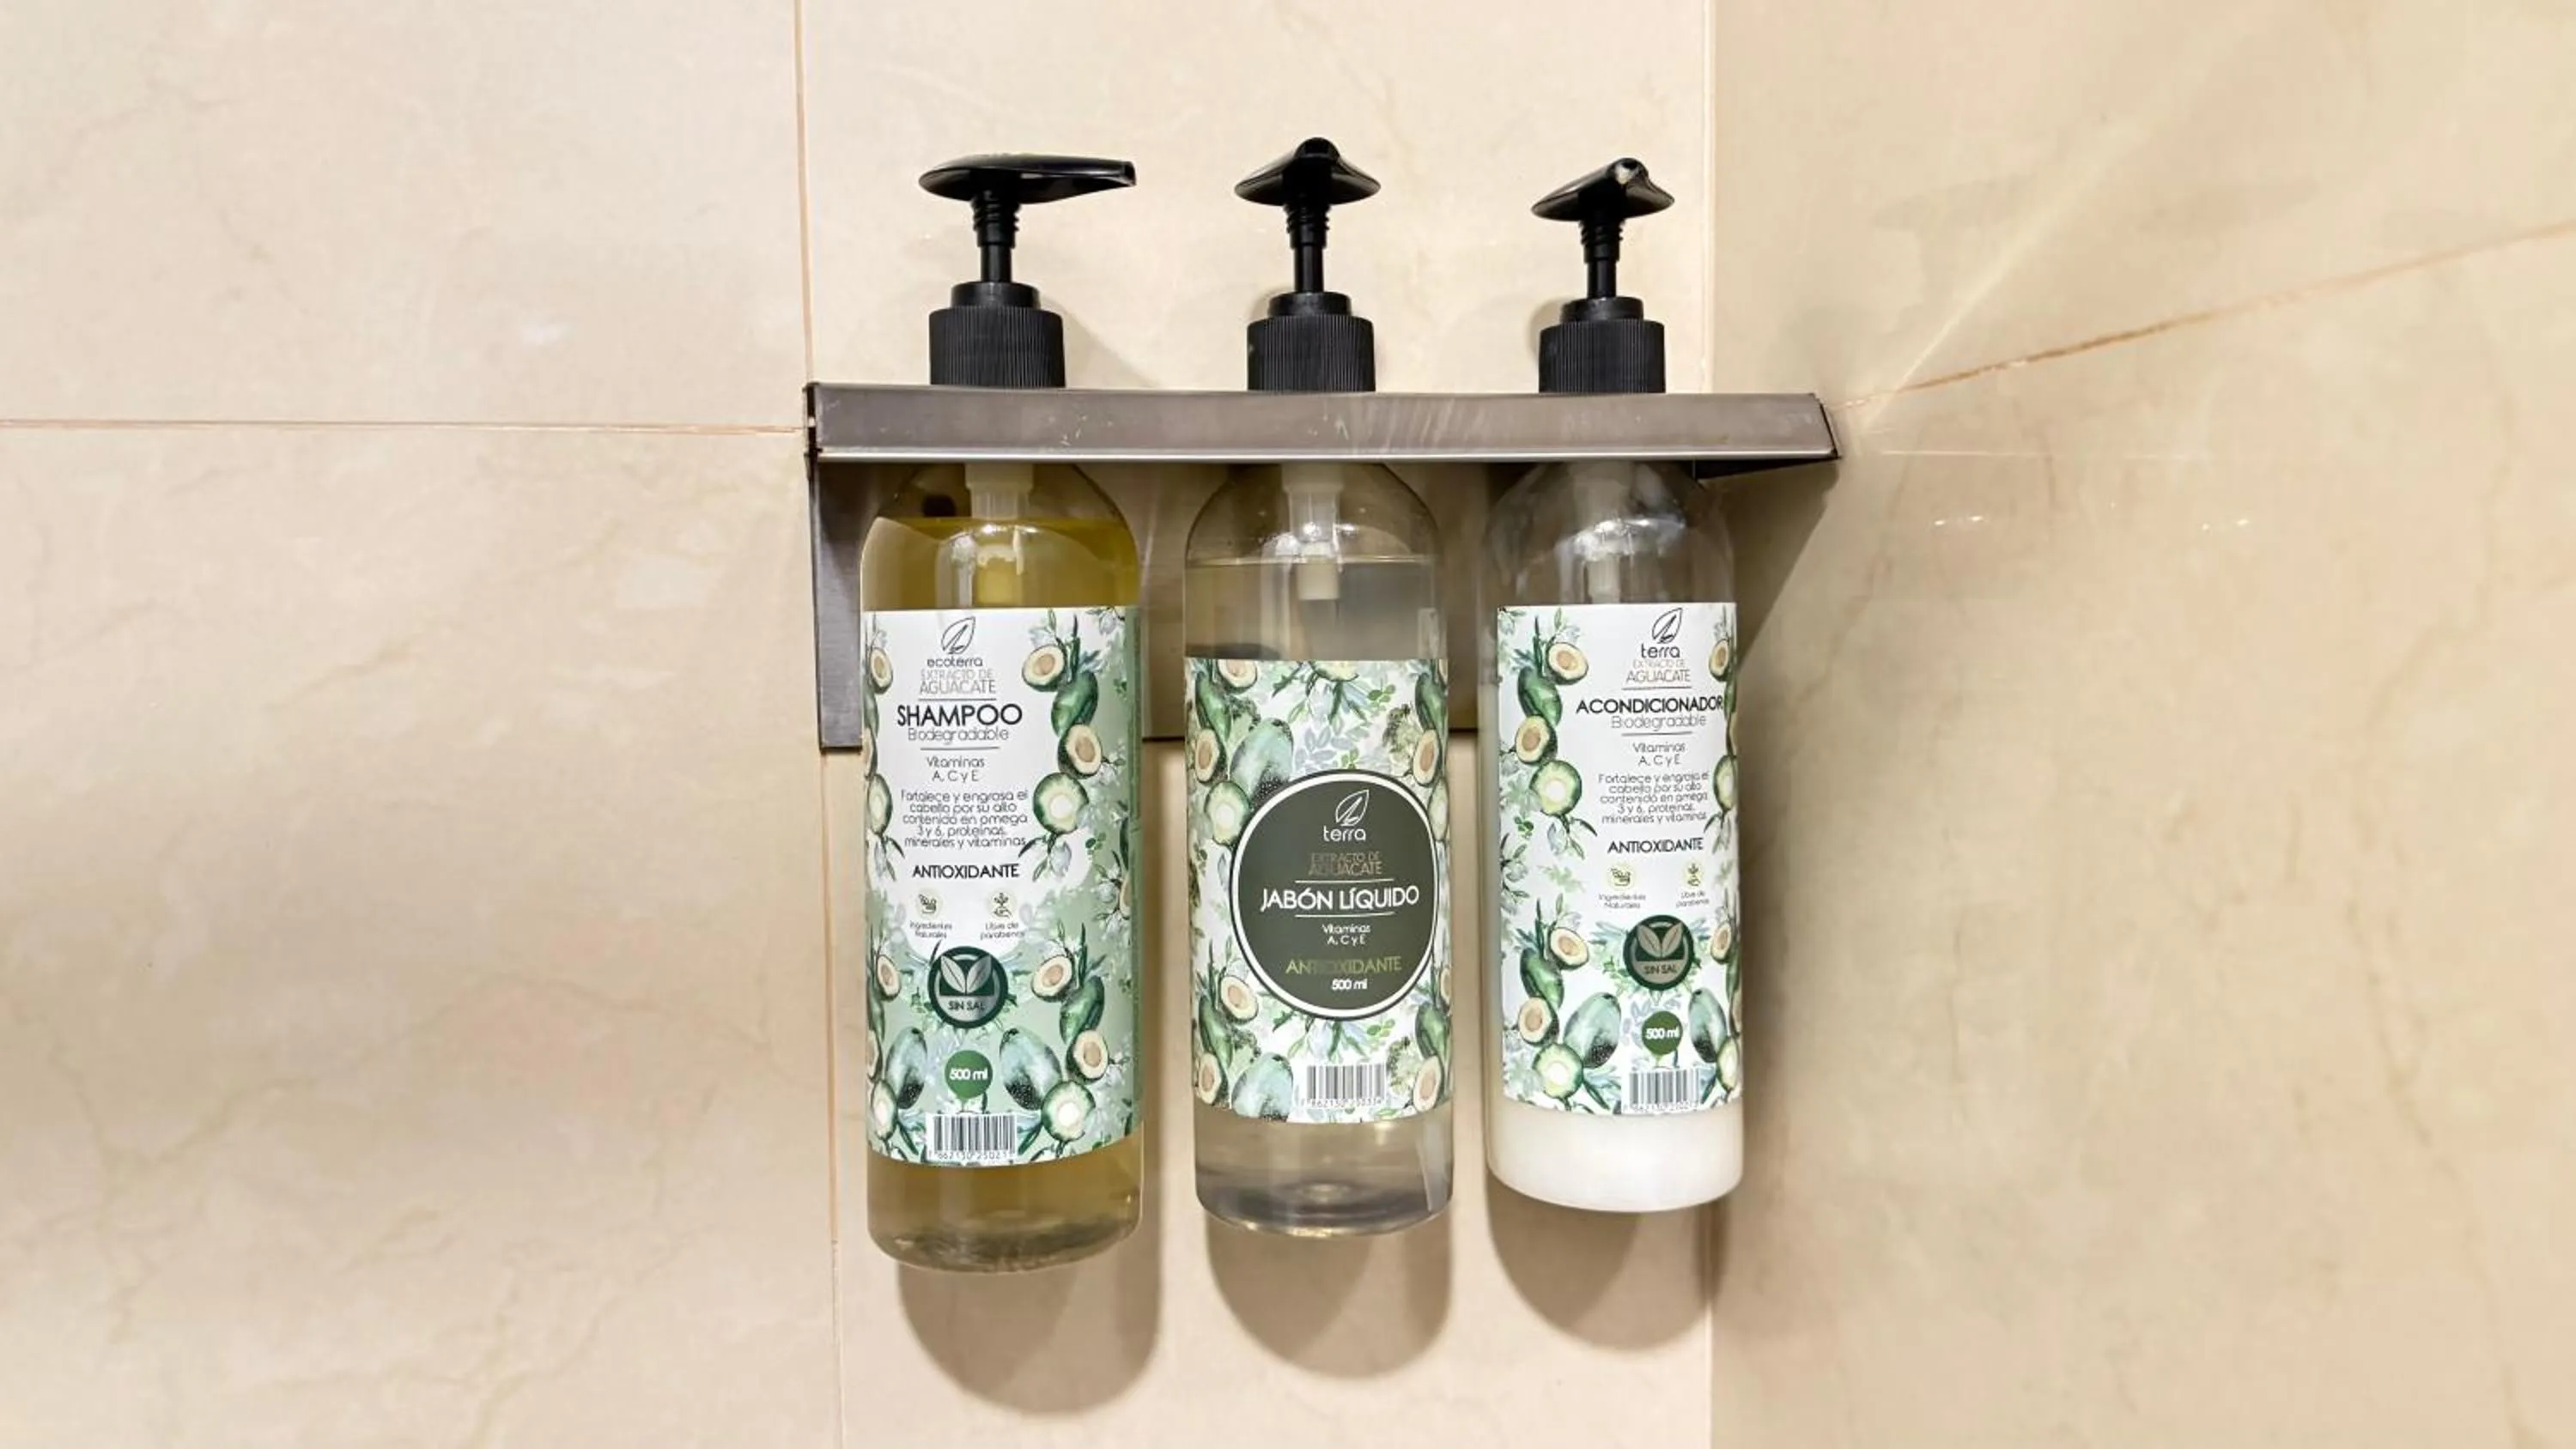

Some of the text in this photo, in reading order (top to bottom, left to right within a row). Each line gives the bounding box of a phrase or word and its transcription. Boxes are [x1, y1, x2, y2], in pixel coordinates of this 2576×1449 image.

[1641, 644, 1680, 658] terra
[927, 656, 983, 667] ecoterra
[979, 669, 993, 680] DE
[1625, 669, 1691, 683] AGUACATE
[920, 680, 996, 694] AGUACATE
[1576, 695, 1723, 714] ACONDICIONADOR
[897, 703, 1023, 727] SHAMPOO
[1611, 714, 1706, 731] Biodegradable
[908, 727, 1009, 744] Biodegradable
[1632, 742, 1686, 753] Vitaminas
[927, 755, 985, 767] Vitaminas
[1653, 755, 1663, 765] C
[1666, 756, 1673, 767] y
[1674, 754, 1680, 764] E
[947, 771, 957, 781] C
[961, 773, 968, 783] y
[972, 770, 979, 781] E
[1598, 773, 1652, 784] Fortalece
[1653, 774, 1660, 784] y
[1654, 784, 1672, 794] por
[902, 790, 950, 801] Fortalece
[953, 792, 960, 803] y
[1600, 793, 1658, 804] contenido
[1660, 794, 1674, 803] en
[909, 803, 1017, 815] cabello por su alto
[1627, 805, 1634, 814] y
[902, 815, 957, 825] contenido
[980, 815, 1027, 826] omega
[1601, 814, 1655, 824] minerales
[1657, 815, 1663, 825] y
[925, 828, 932, 837] y
[1323, 825, 1366, 842] terra
[905, 837, 955, 847] minerales
[957, 840, 964, 849] y
[1607, 837, 1704, 853] ANTIOXIDANTE
[912, 864, 1020, 879] ANTIOXIDANTE
[1308, 861, 1382, 876] AGUACATE
[1261, 885, 1419, 912] JABÓN LÍQUIDO
[1322, 924, 1370, 934] Vitaminas
[1340, 935, 1349, 944] C
[1352, 937, 1358, 946] y
[1360, 934, 1366, 944] E
[1285, 956, 1402, 974] ANOXIDANTE
[1643, 964, 1677, 975] SIN SAL
[1332, 978, 1368, 991] 500 ml
[948, 1000, 985, 1010] SIN SAL
[1645, 1026, 1680, 1040] 500 ml
[949, 1067, 988, 1081] 500 ml
